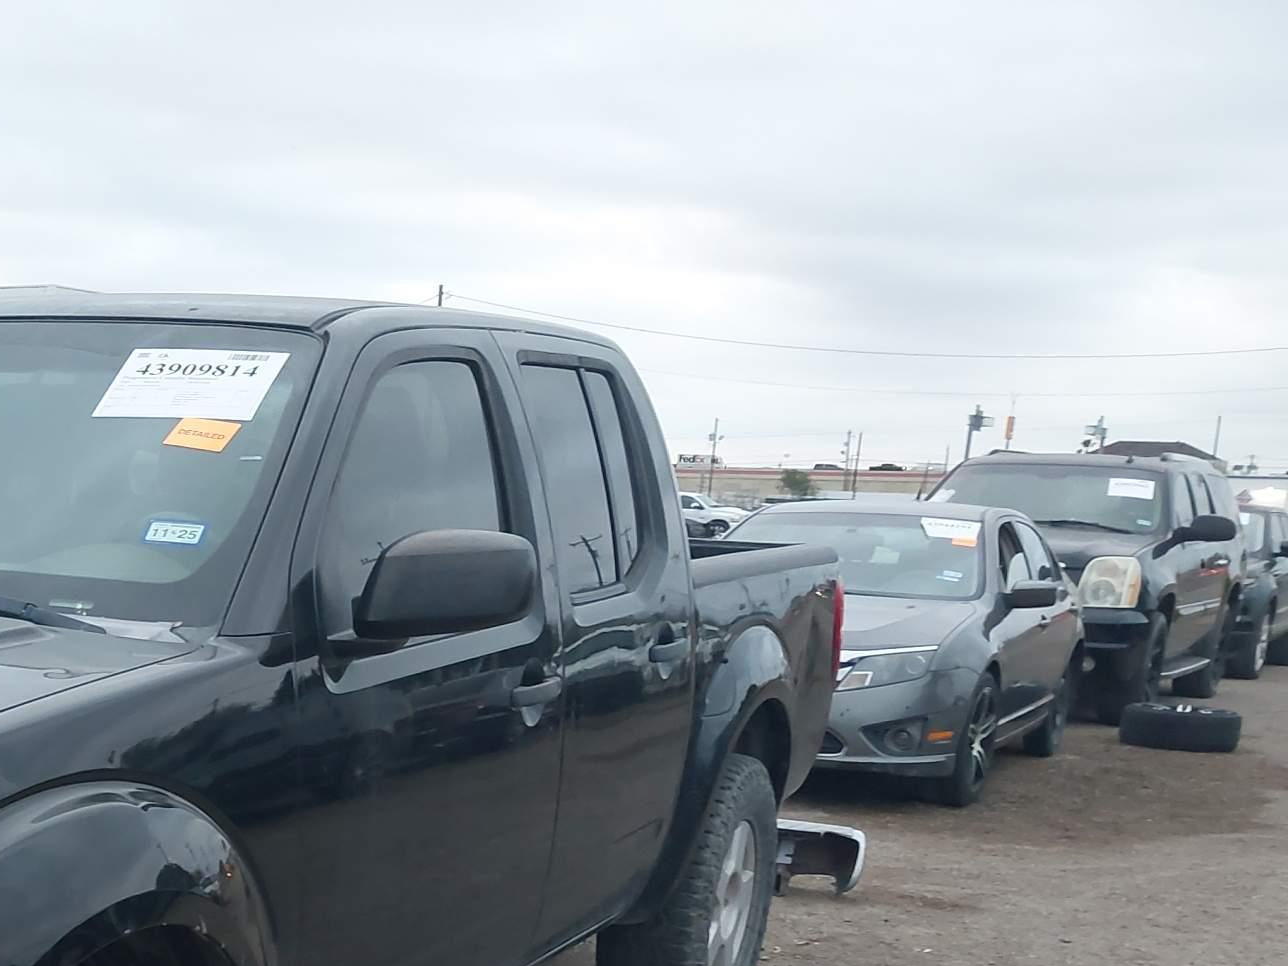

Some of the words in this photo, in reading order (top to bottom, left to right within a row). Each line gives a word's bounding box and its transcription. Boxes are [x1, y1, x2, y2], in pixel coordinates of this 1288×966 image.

[135, 363, 261, 377] 43909814
[177, 428, 226, 440] DETAILED
[679, 454, 705, 464] FedEx
